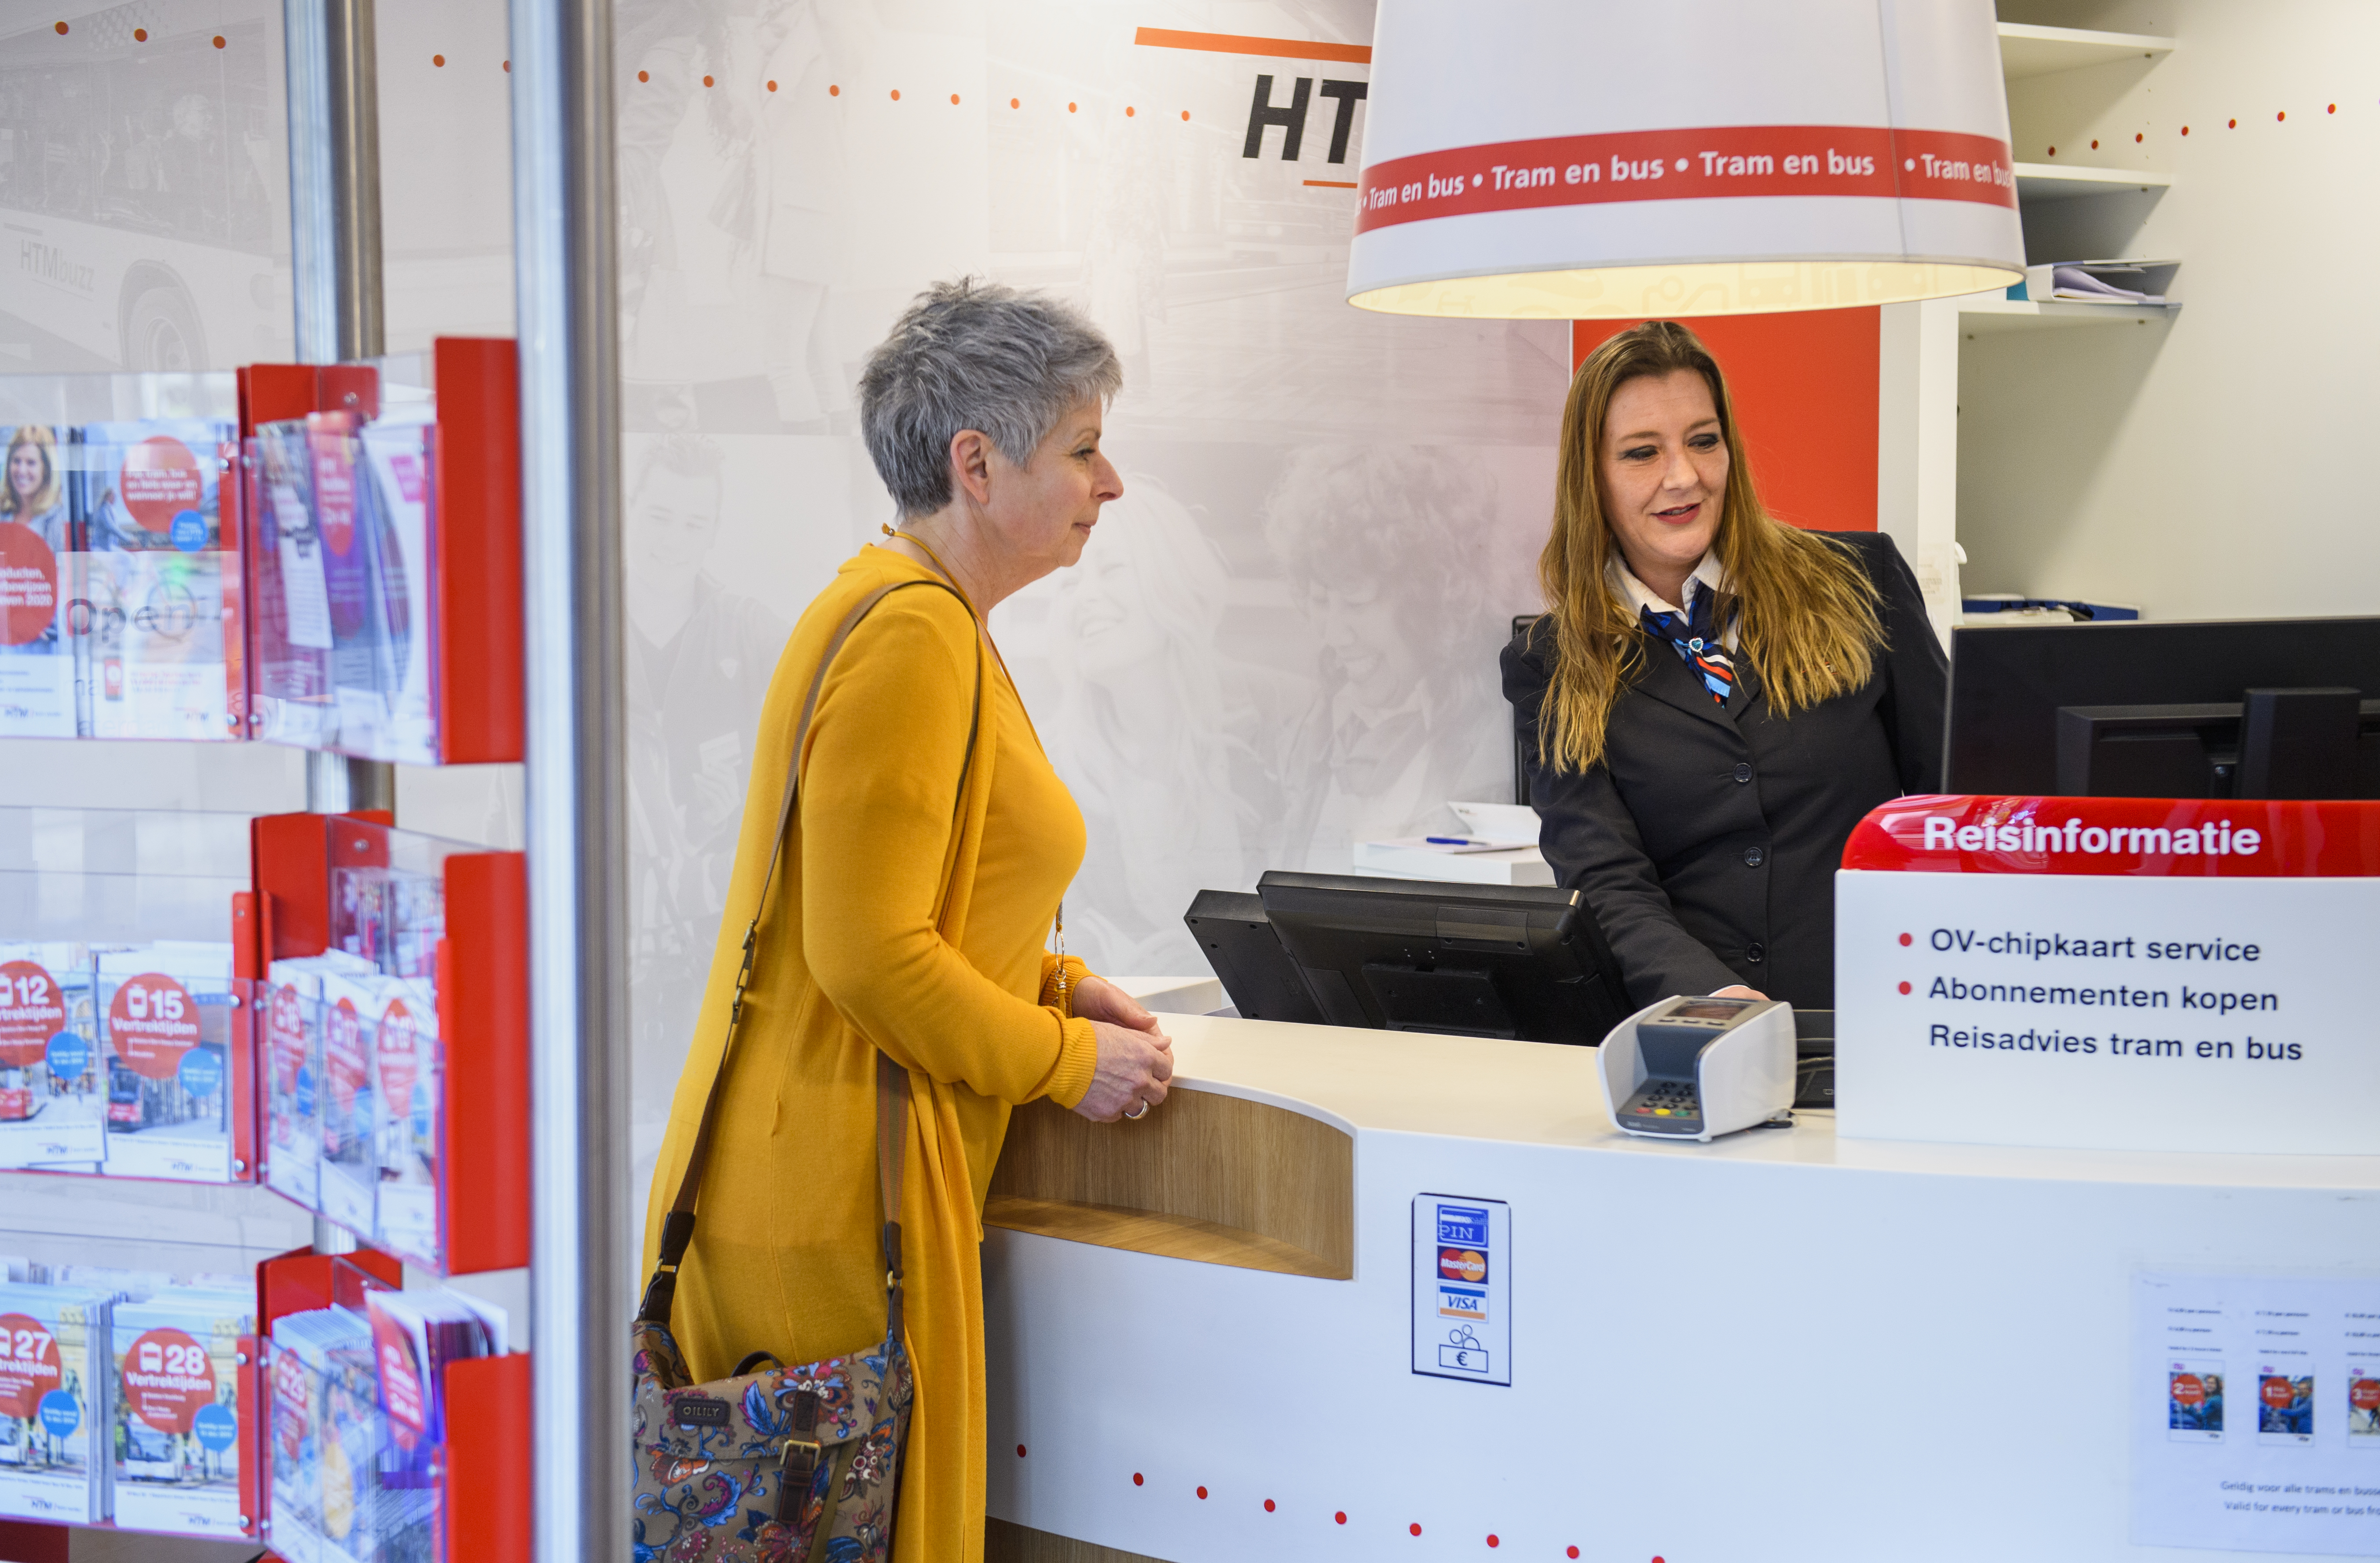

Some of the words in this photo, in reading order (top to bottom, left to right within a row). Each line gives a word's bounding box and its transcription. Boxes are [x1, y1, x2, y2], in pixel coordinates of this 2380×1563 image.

[1369, 186, 1397, 211] Tram
[1401, 182, 1421, 203] en
[1428, 174, 1464, 199] bus
[1492, 165, 1556, 190] Tram
[1565, 161, 1600, 185] en
[1611, 155, 1664, 183] bus
[1699, 150, 1773, 176] Tram
[1783, 153, 1819, 175] en
[1827, 149, 1875, 176] bus
[1920, 154, 1970, 181] Tram
[1973, 163, 1992, 184] en
[26, 595, 53, 606] 2020
[1924, 816, 2261, 855] Reisinformatie
[1931, 928, 2135, 960] OV-chipkaart
[2147, 938, 2261, 961] service
[14, 975, 50, 1006] 12
[1929, 976, 2169, 1008] Abonnementen
[2182, 986, 2278, 1015] kopen
[150, 989, 185, 1019] 15
[112, 1018, 198, 1036] Vertrektijden
[1930, 1024, 2098, 1054] Reisadvies
[2110, 1033, 2182, 1056] tram
[2196, 1040, 2234, 1058] en
[2247, 1036, 2303, 1060] bus
[1438, 1224, 1473, 1240] PIN
[1440, 1257, 1485, 1273] MasterCard
[1447, 1295, 1478, 1311] VISA
[14, 1329, 51, 1361] 27
[165, 1344, 205, 1376] 28
[125, 1371, 212, 1392] Vertrektijden
[2173, 1383, 2185, 1395] 2
[2265, 1386, 2272, 1397] 1
[2353, 1388, 2362, 1400] 3
[683, 1406, 719, 1417] OILILY
[2220, 1480, 2255, 1493] Geldig
[2284, 1483, 2303, 1493] alle
[2305, 1485, 2336, 1494] trams
[2224, 1501, 2252, 1512] Valid
[2254, 1501, 2269, 1512] for
[2272, 1505, 2301, 1515] every
[2303, 1505, 2329, 1514] tram
[2346, 1505, 2365, 1515] bus
